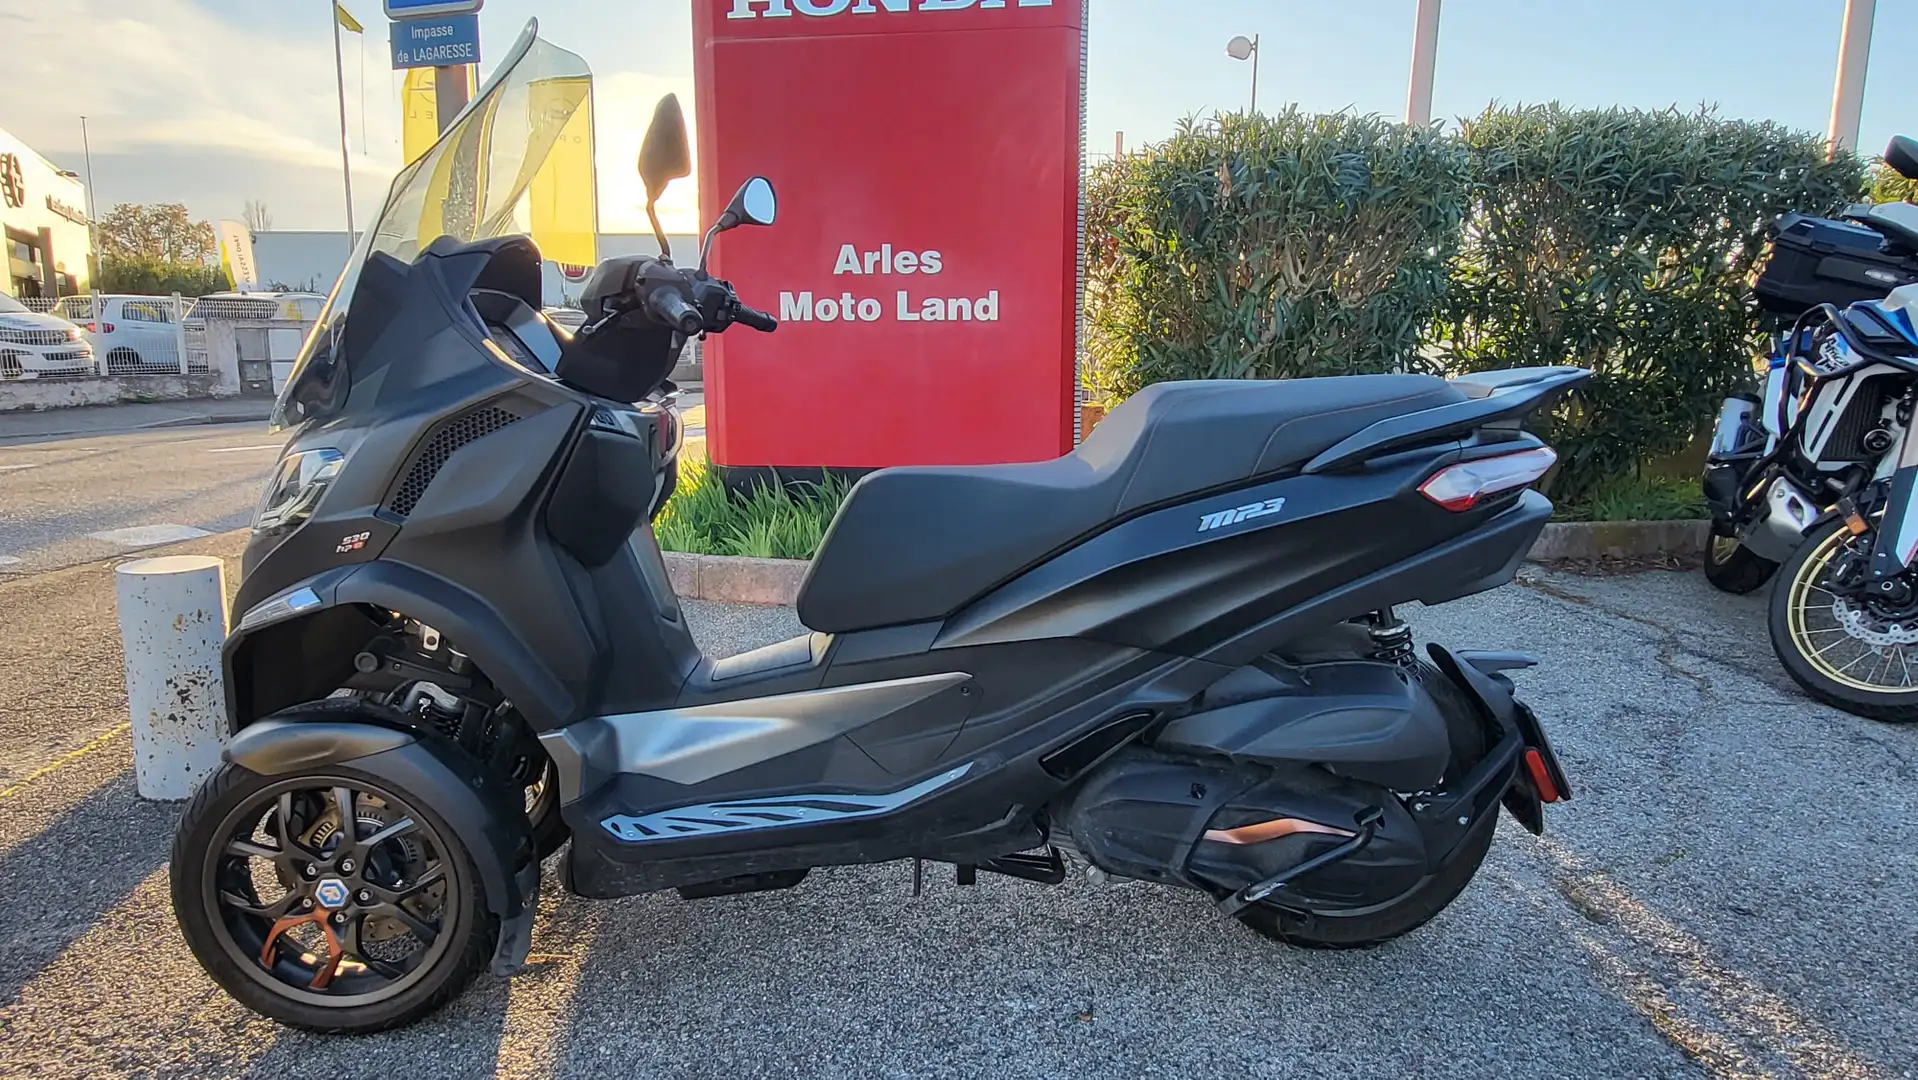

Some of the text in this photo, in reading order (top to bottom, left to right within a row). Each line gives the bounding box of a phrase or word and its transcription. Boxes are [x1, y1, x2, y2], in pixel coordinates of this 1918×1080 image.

[411, 26, 454, 41] Impasse
[397, 43, 473, 63] de LAGARESSE
[833, 244, 943, 275] Arles
[780, 290, 998, 322] Moto Land
[1198, 497, 1286, 532] MP3
[342, 531, 371, 545] 530
